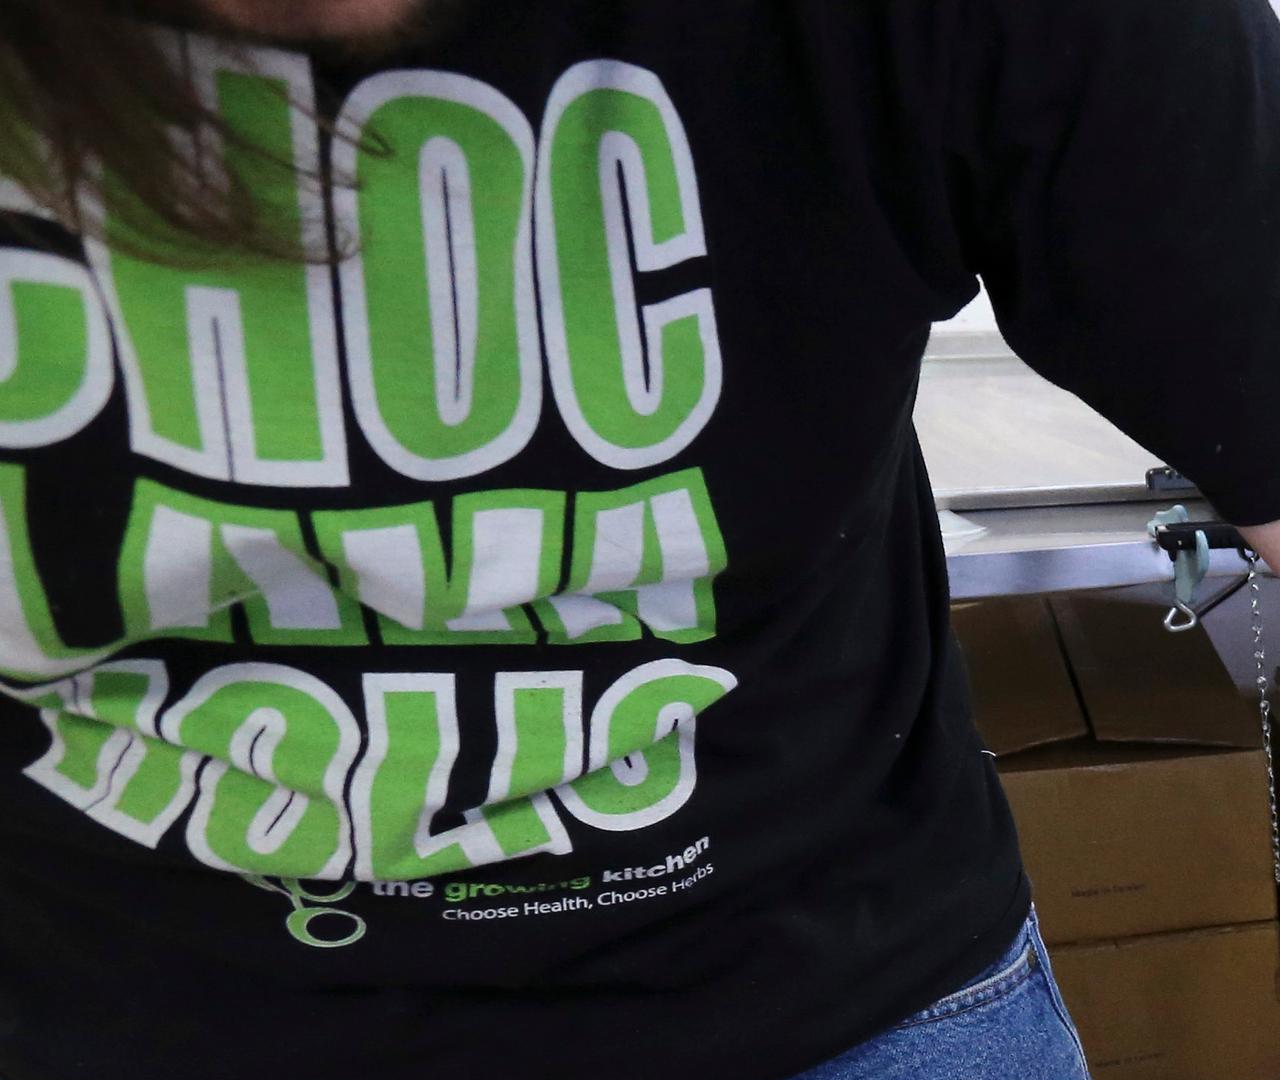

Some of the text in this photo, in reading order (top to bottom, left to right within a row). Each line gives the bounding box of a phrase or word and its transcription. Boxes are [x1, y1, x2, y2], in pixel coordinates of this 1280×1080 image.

[372, 834, 711, 902] the growg kitchen
[442, 861, 715, 921] Choose Health, Choose Herbs
